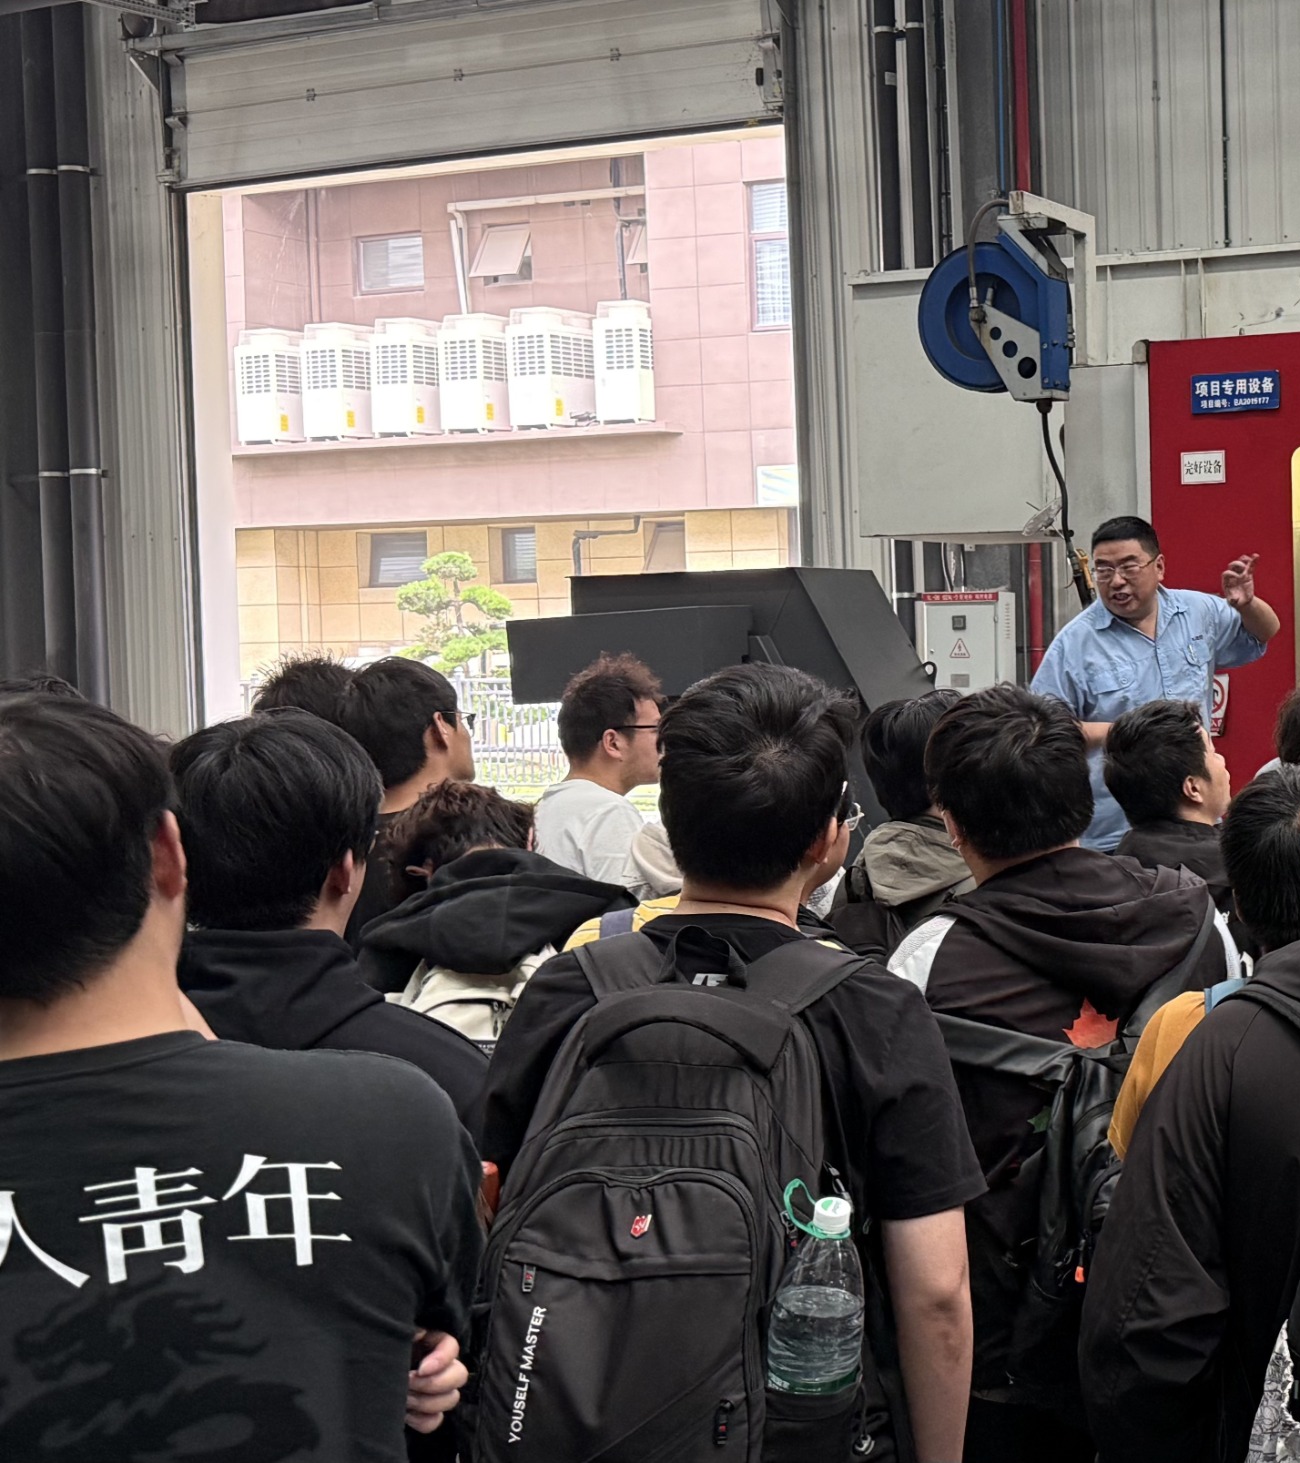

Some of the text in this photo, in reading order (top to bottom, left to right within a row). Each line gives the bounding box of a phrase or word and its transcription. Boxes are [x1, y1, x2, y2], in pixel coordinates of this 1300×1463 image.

[1195, 377, 1274, 397] 项目专用设备
[1184, 460, 1221, 475] 完好设备
[508, 1306, 547, 1443] YOUSELF MASTER
